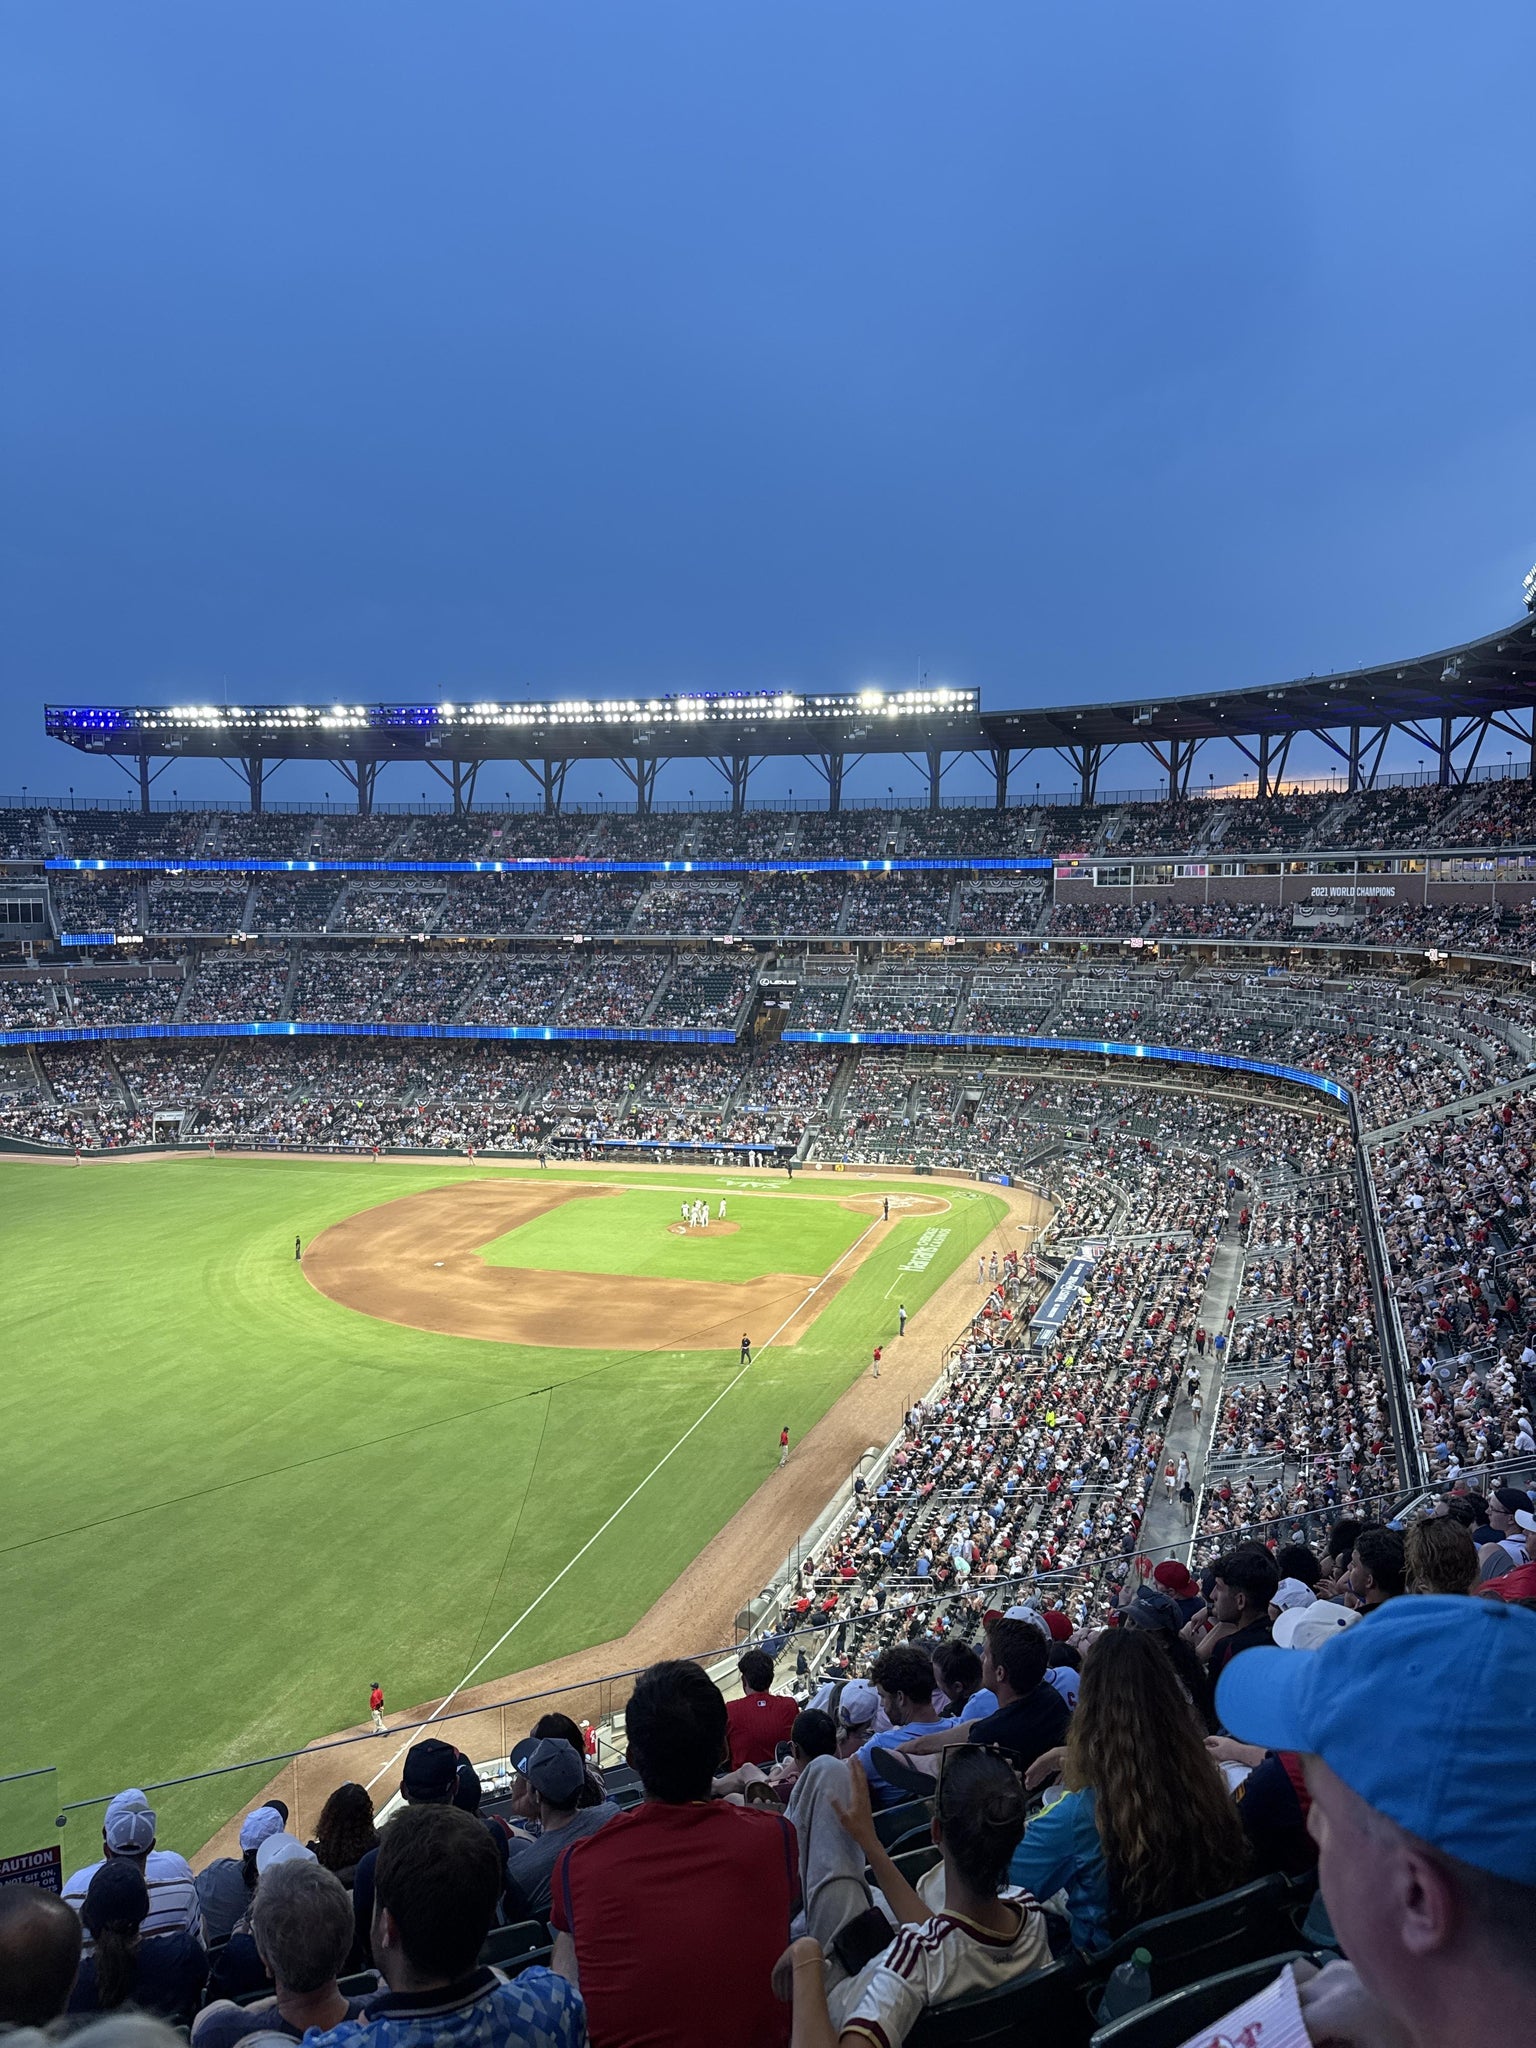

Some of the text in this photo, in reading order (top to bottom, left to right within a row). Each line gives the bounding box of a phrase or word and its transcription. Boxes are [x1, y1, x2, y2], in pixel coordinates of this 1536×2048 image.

[1311, 887, 1396, 897] 2021 WORLD CHAMPIONS
[0, 1851, 53, 1874] AUTION
[25, 1872, 38, 1881] SIT
[42, 1877, 55, 1886] OR
